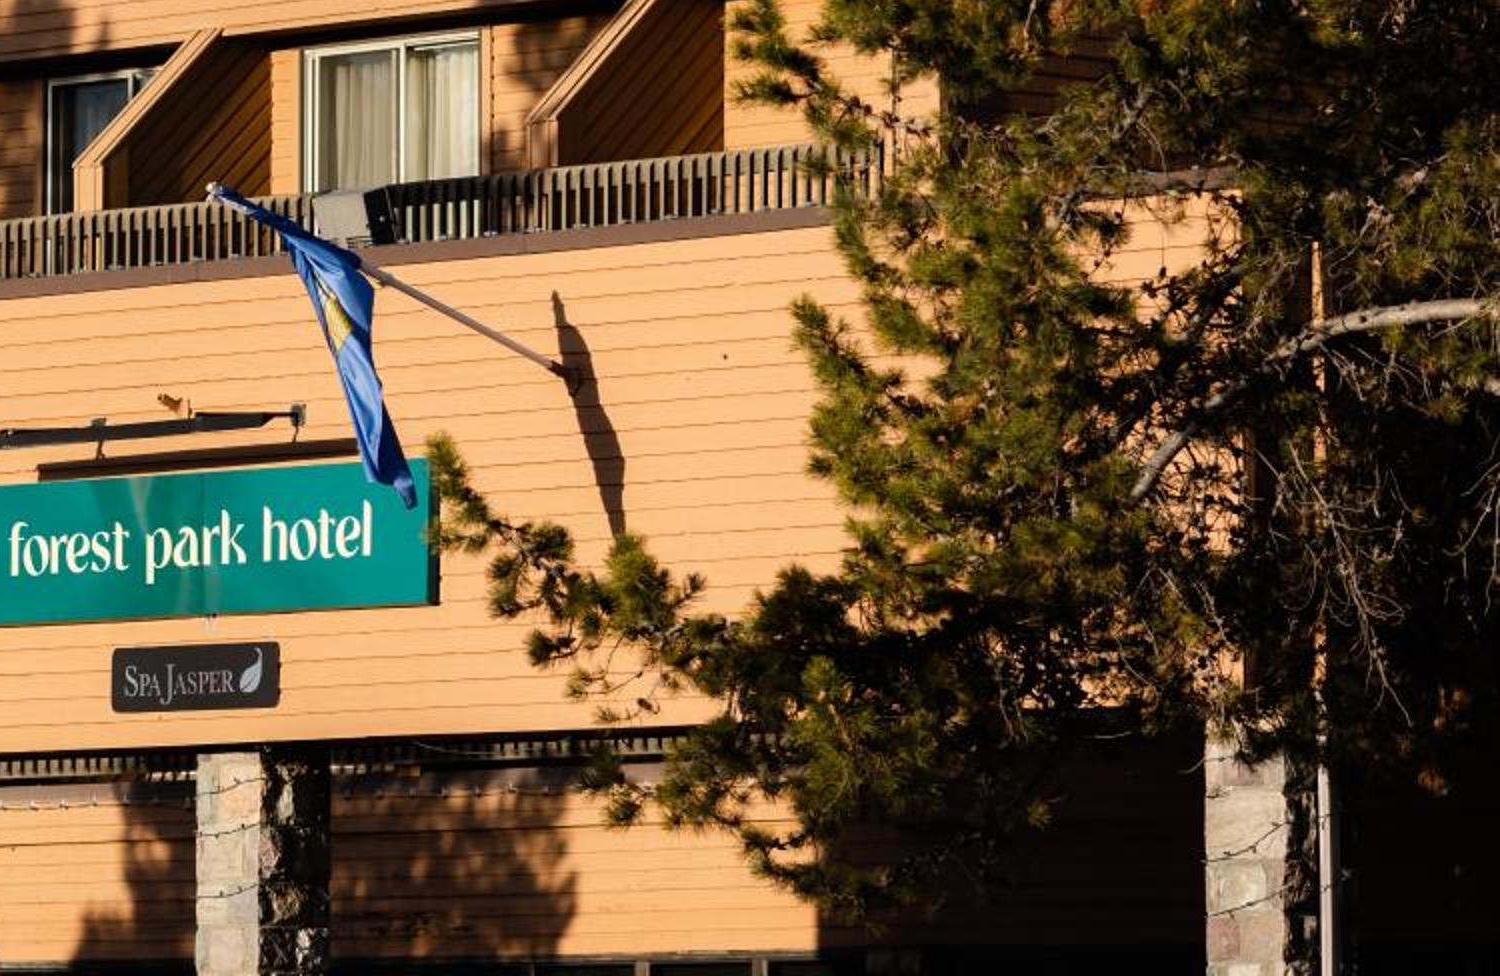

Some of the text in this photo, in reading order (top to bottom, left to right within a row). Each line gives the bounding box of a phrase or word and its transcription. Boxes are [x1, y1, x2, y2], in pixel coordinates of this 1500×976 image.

[8, 499, 372, 585] forest park hotel
